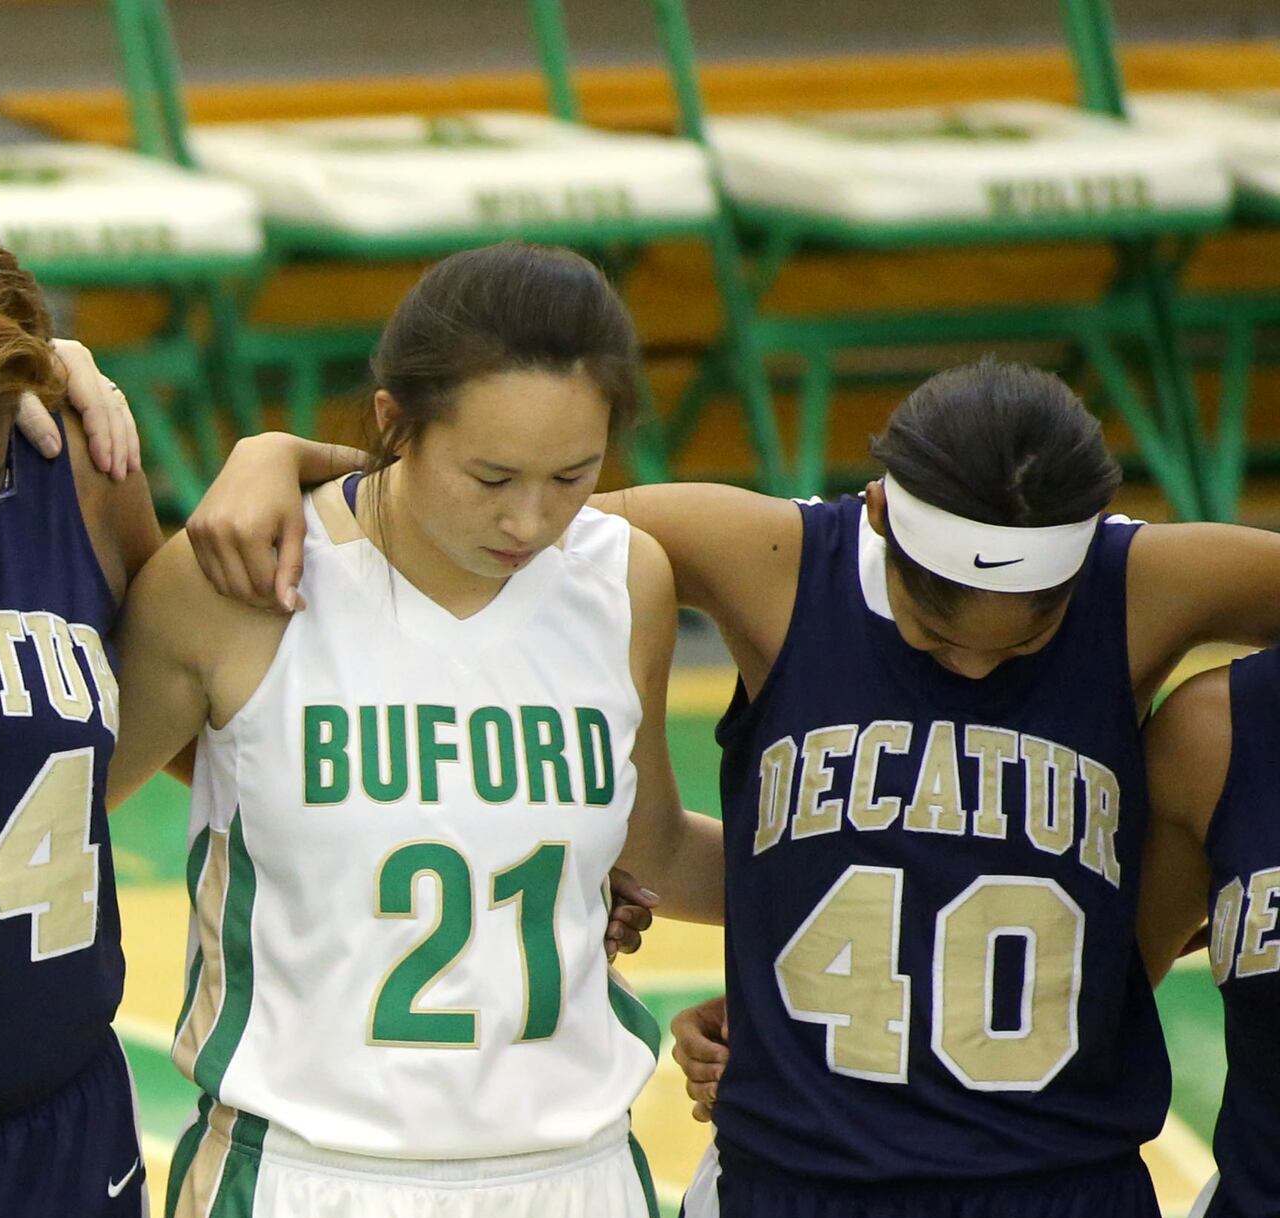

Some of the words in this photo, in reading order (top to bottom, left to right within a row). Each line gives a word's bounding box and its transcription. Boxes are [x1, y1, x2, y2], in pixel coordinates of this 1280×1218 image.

[301, 704, 616, 808] BUFORD
[752, 720, 1121, 890] DECATUR
[365, 838, 571, 1050] 21
[773, 864, 1086, 1093] 40
